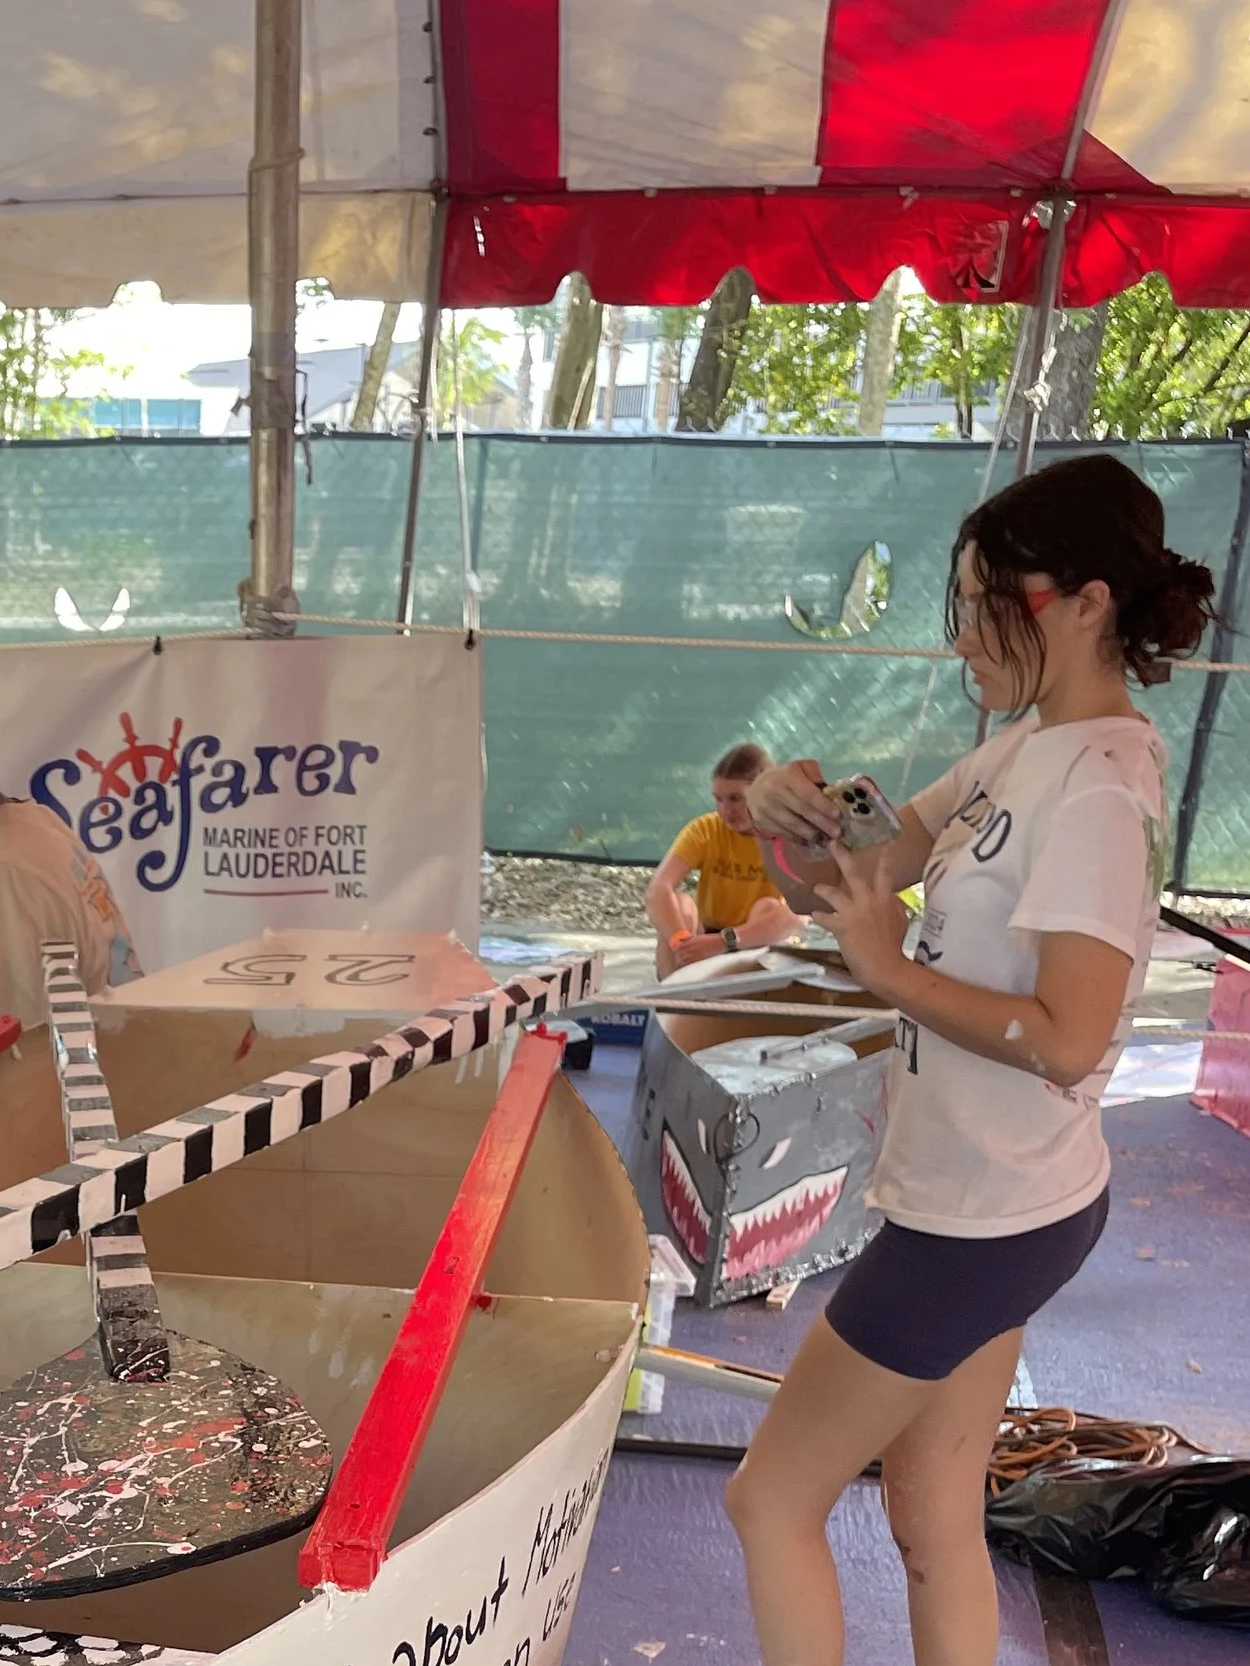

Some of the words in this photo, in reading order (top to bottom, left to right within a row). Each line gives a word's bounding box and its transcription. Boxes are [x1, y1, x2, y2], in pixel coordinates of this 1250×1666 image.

[30, 735, 380, 893] Seafarer
[203, 827, 279, 849] MARINE
[285, 826, 308, 847] OF
[314, 825, 367, 847] FORT
[203, 850, 367, 879] LAUDERDALE
[335, 882, 368, 899] INC.
[591, 1011, 646, 1027] KOBALT
